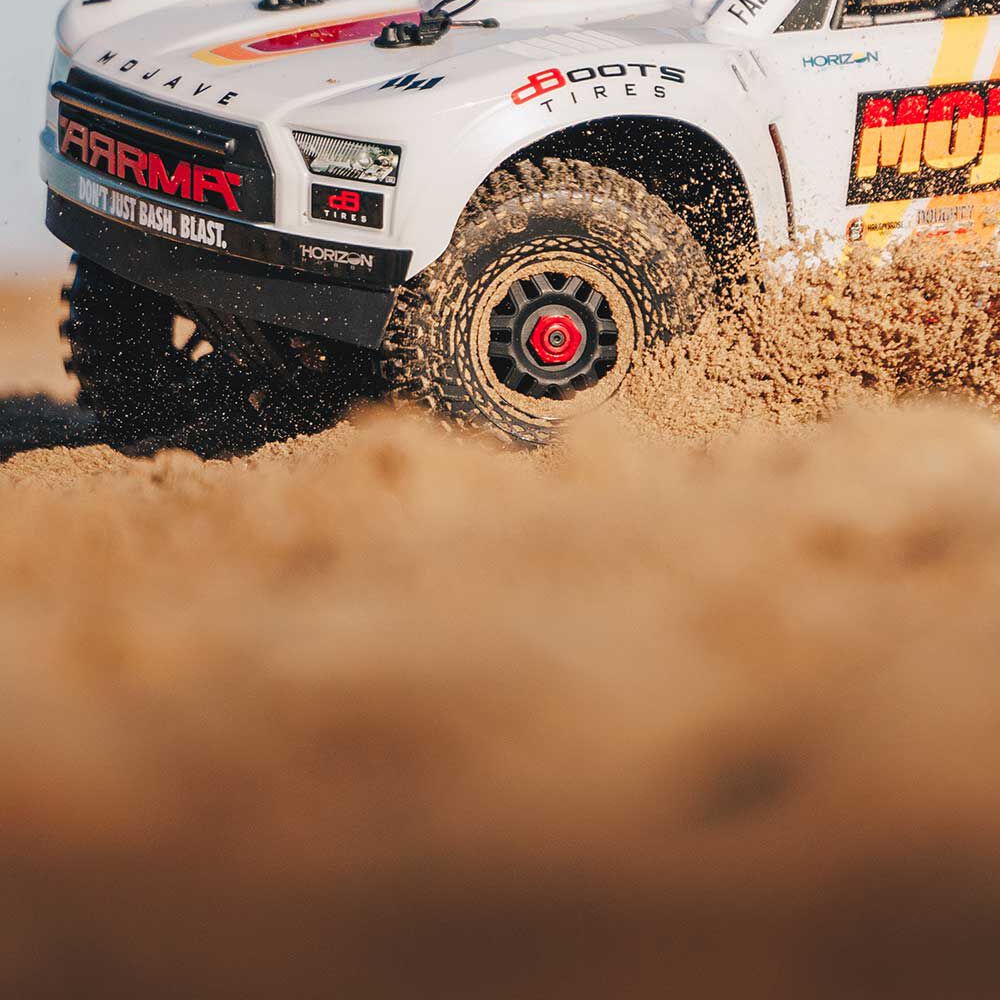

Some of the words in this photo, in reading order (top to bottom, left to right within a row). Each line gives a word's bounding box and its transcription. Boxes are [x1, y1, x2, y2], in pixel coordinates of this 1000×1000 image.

[802, 50, 879, 68] HORIZON
[97, 50, 239, 106] MOJAVE
[540, 83, 667, 113] TIRES
[79, 176, 109, 211] DON'T
[111, 190, 137, 223] JUST
[139, 200, 177, 236] BASH.
[180, 213, 228, 250] BLAST.
[323, 208, 368, 224] TIRES
[299, 244, 375, 268] HORIZON
